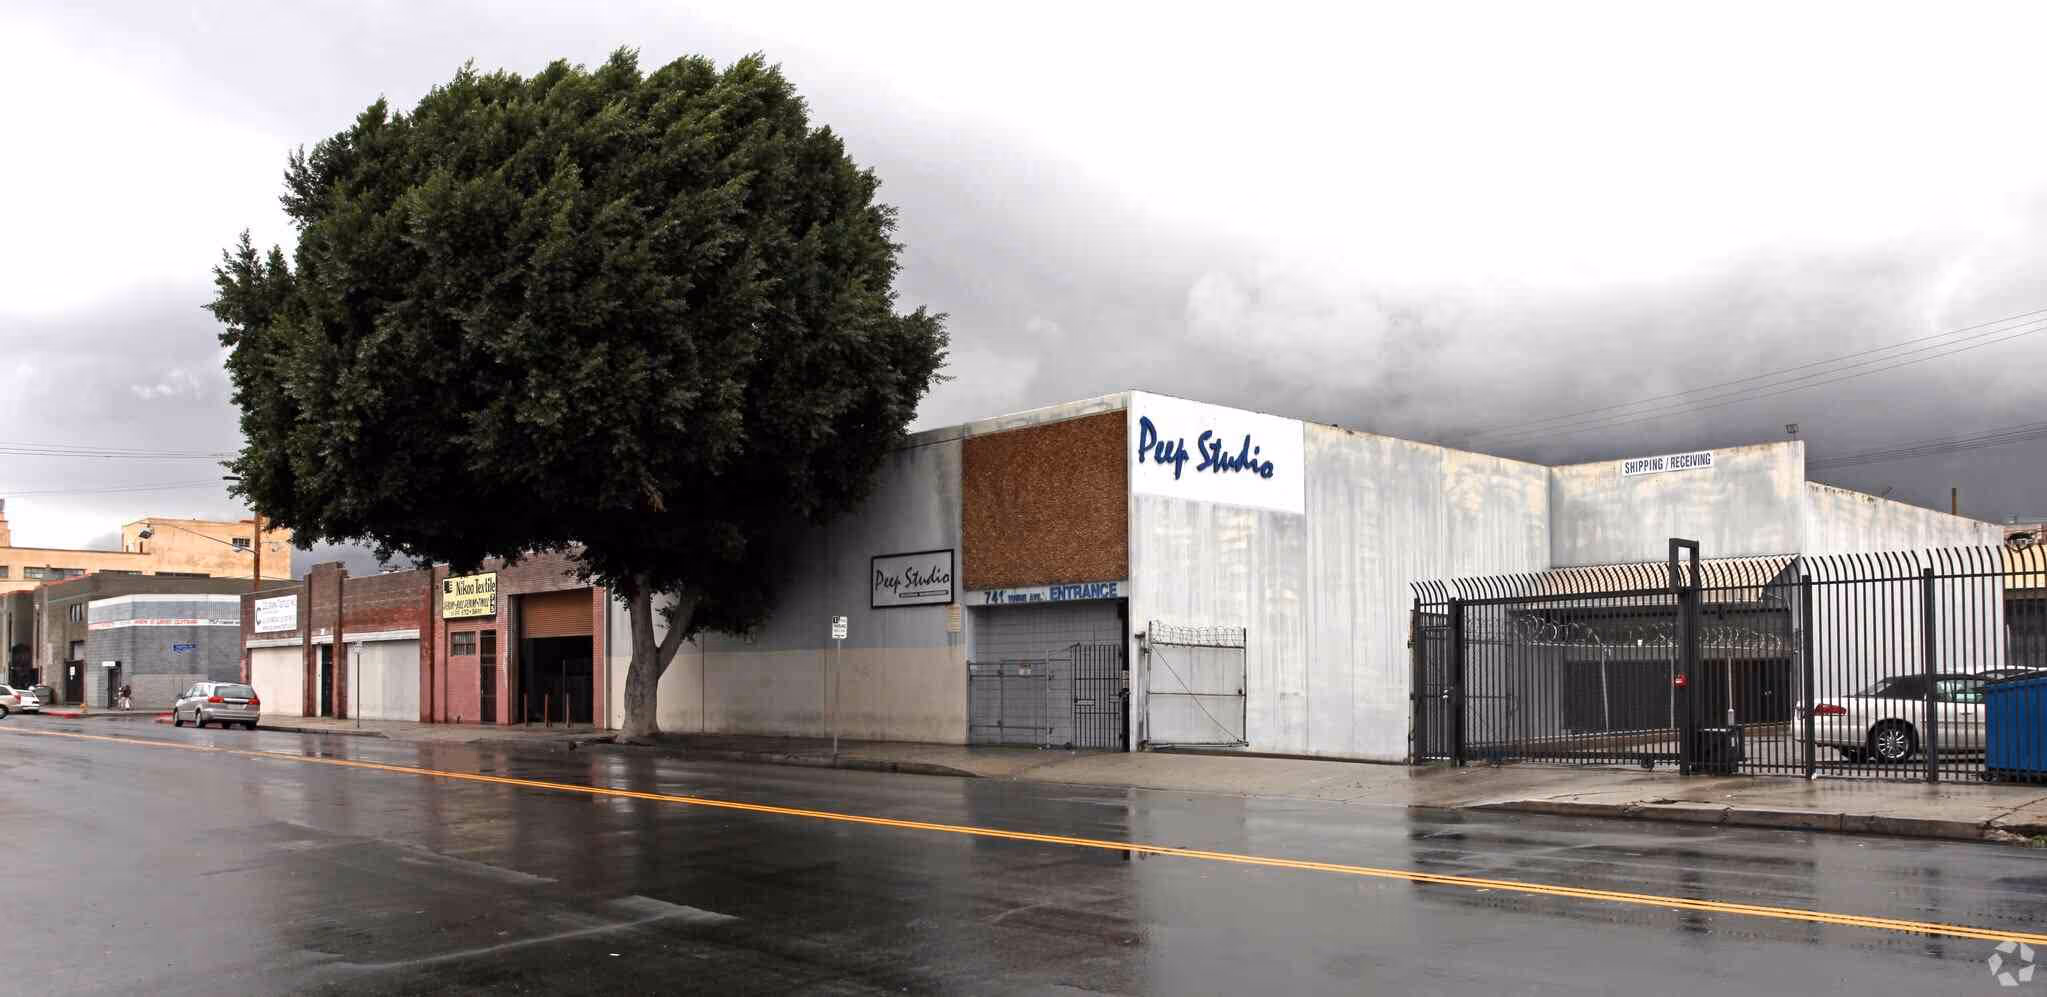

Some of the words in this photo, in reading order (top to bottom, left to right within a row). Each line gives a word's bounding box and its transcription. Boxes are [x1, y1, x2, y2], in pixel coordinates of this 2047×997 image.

[1138, 415, 1189, 480] Peep
[1196, 430, 1274, 479] Studio
[1624, 458, 1663, 474] SHIPPING
[1671, 452, 1711, 469] RECEIVING
[475, 577, 496, 593] Textile
[875, 569, 901, 593] Peep
[905, 565, 950, 588] Studio
[1050, 583, 1118, 600] ENTRANCE
